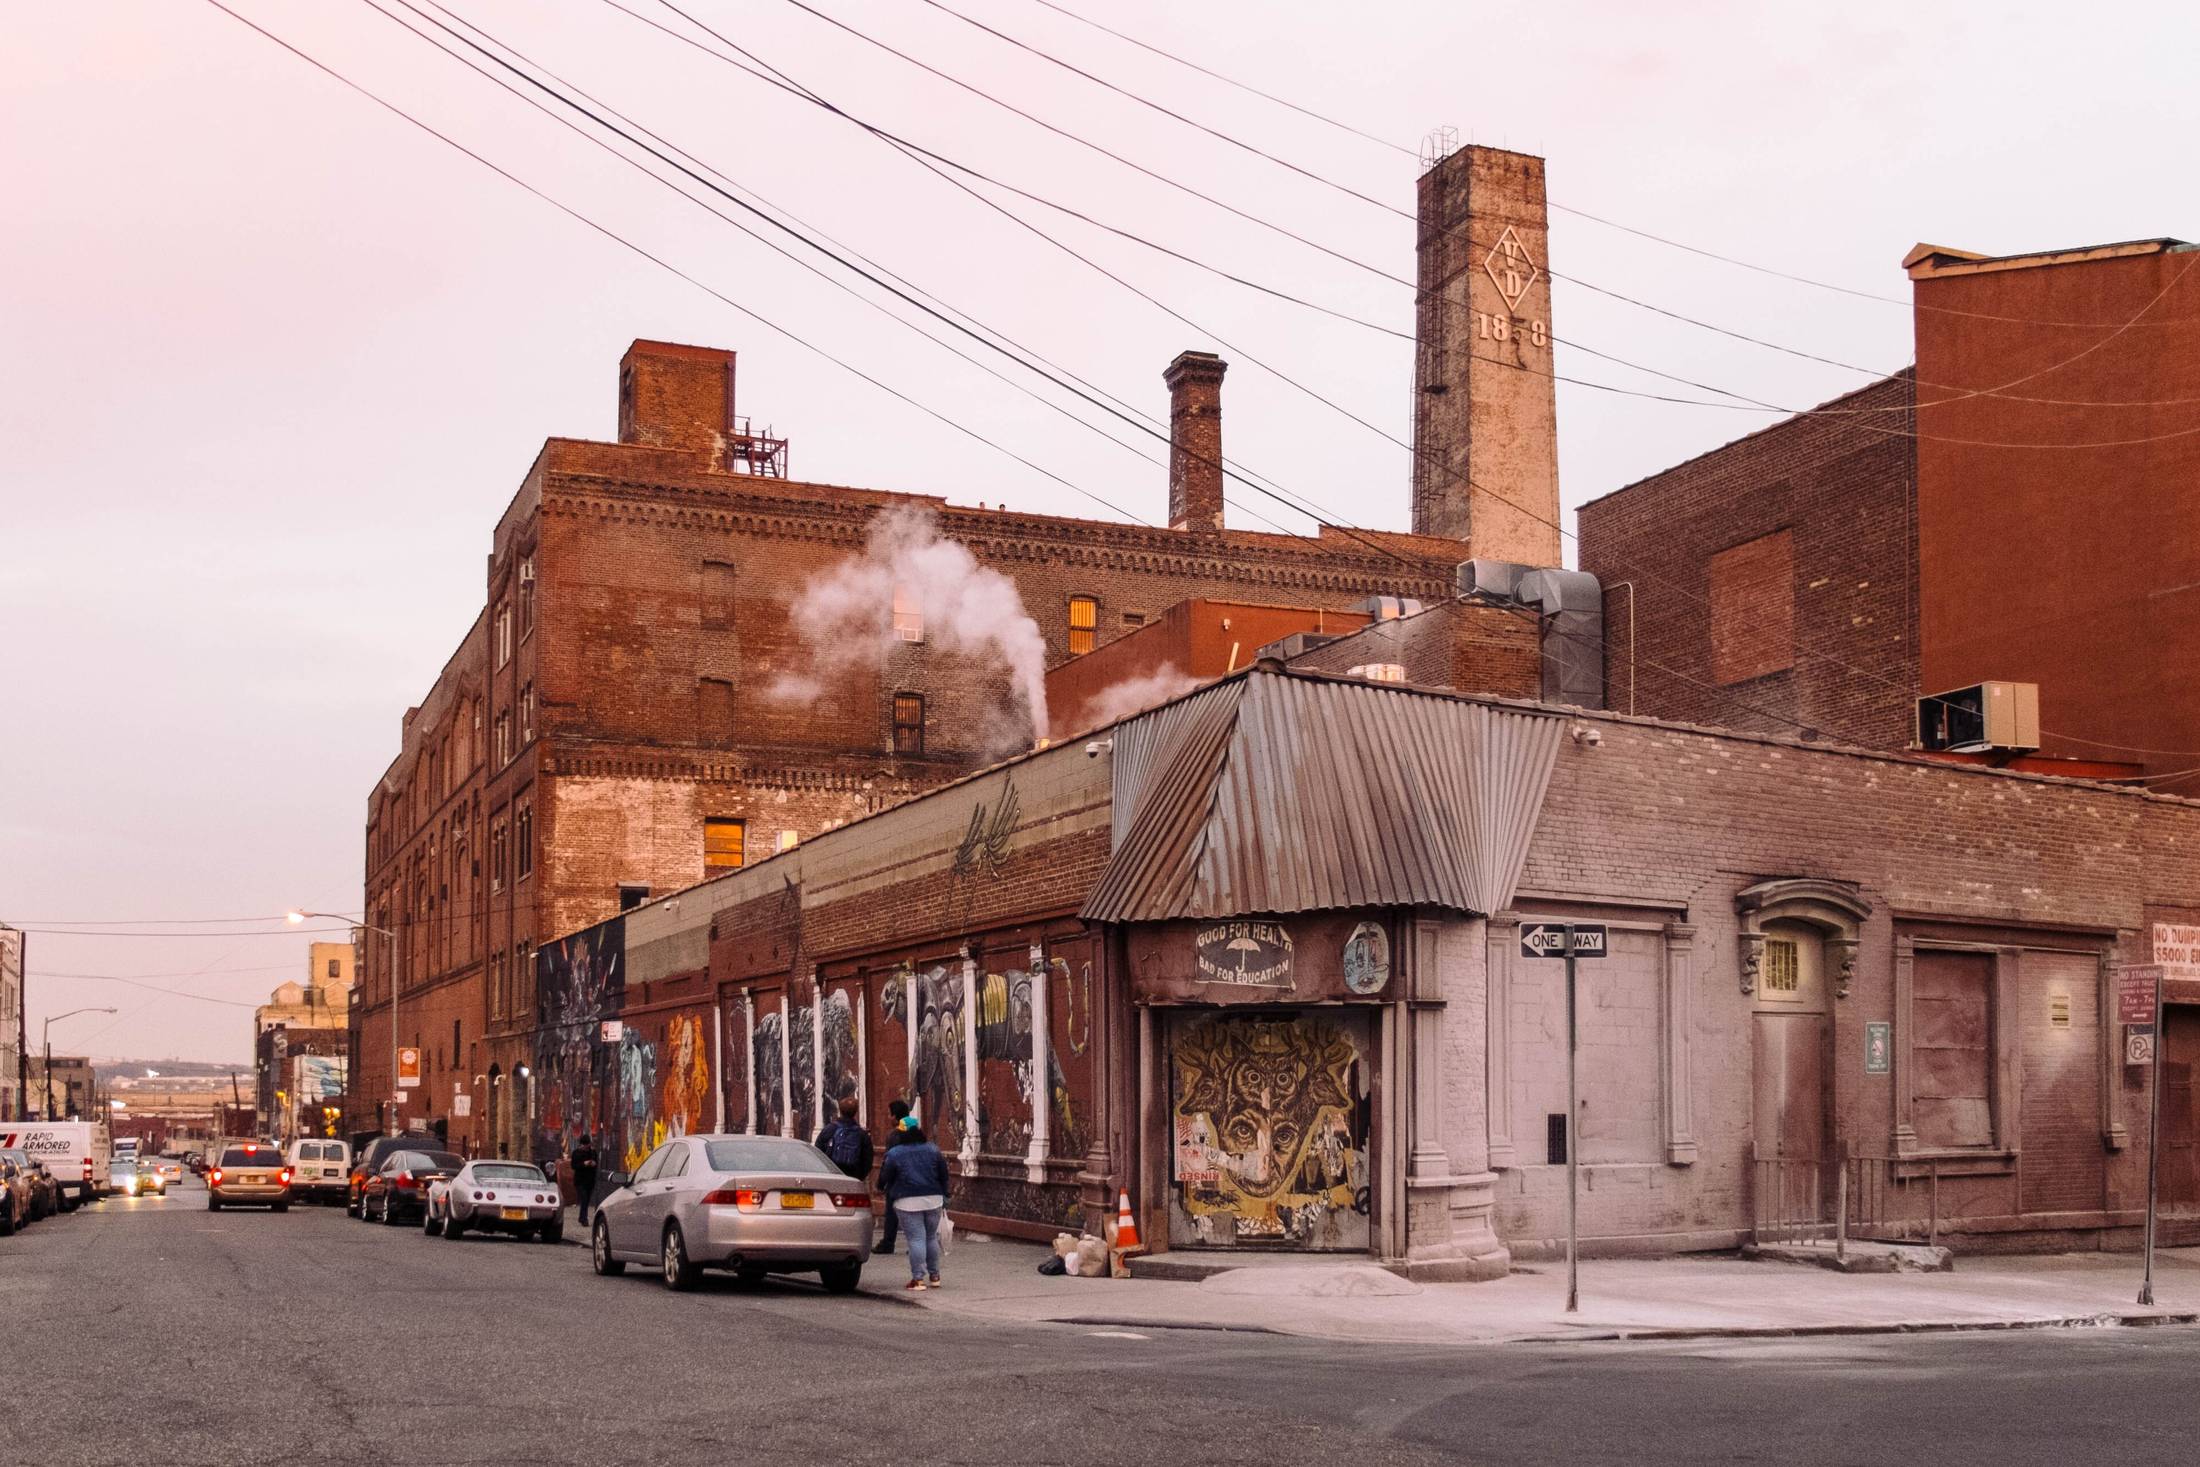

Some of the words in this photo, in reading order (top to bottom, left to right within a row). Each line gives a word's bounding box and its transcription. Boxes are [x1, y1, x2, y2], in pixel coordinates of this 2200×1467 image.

[1197, 925, 1226, 948] GOOD
[1229, 923, 1250, 939] FOR
[1532, 934, 1558, 948] ONE
[1574, 934, 1599, 948] WAY
[2154, 927, 2168, 943] NO
[1199, 955, 1216, 974] BAD
[1217, 967, 1234, 982] FOR
[1236, 959, 1289, 984] EDUCATION
[2119, 971, 2130, 980] NO
[24, 1132, 54, 1141] RAPID
[22, 1141, 71, 1150] ARMORED
